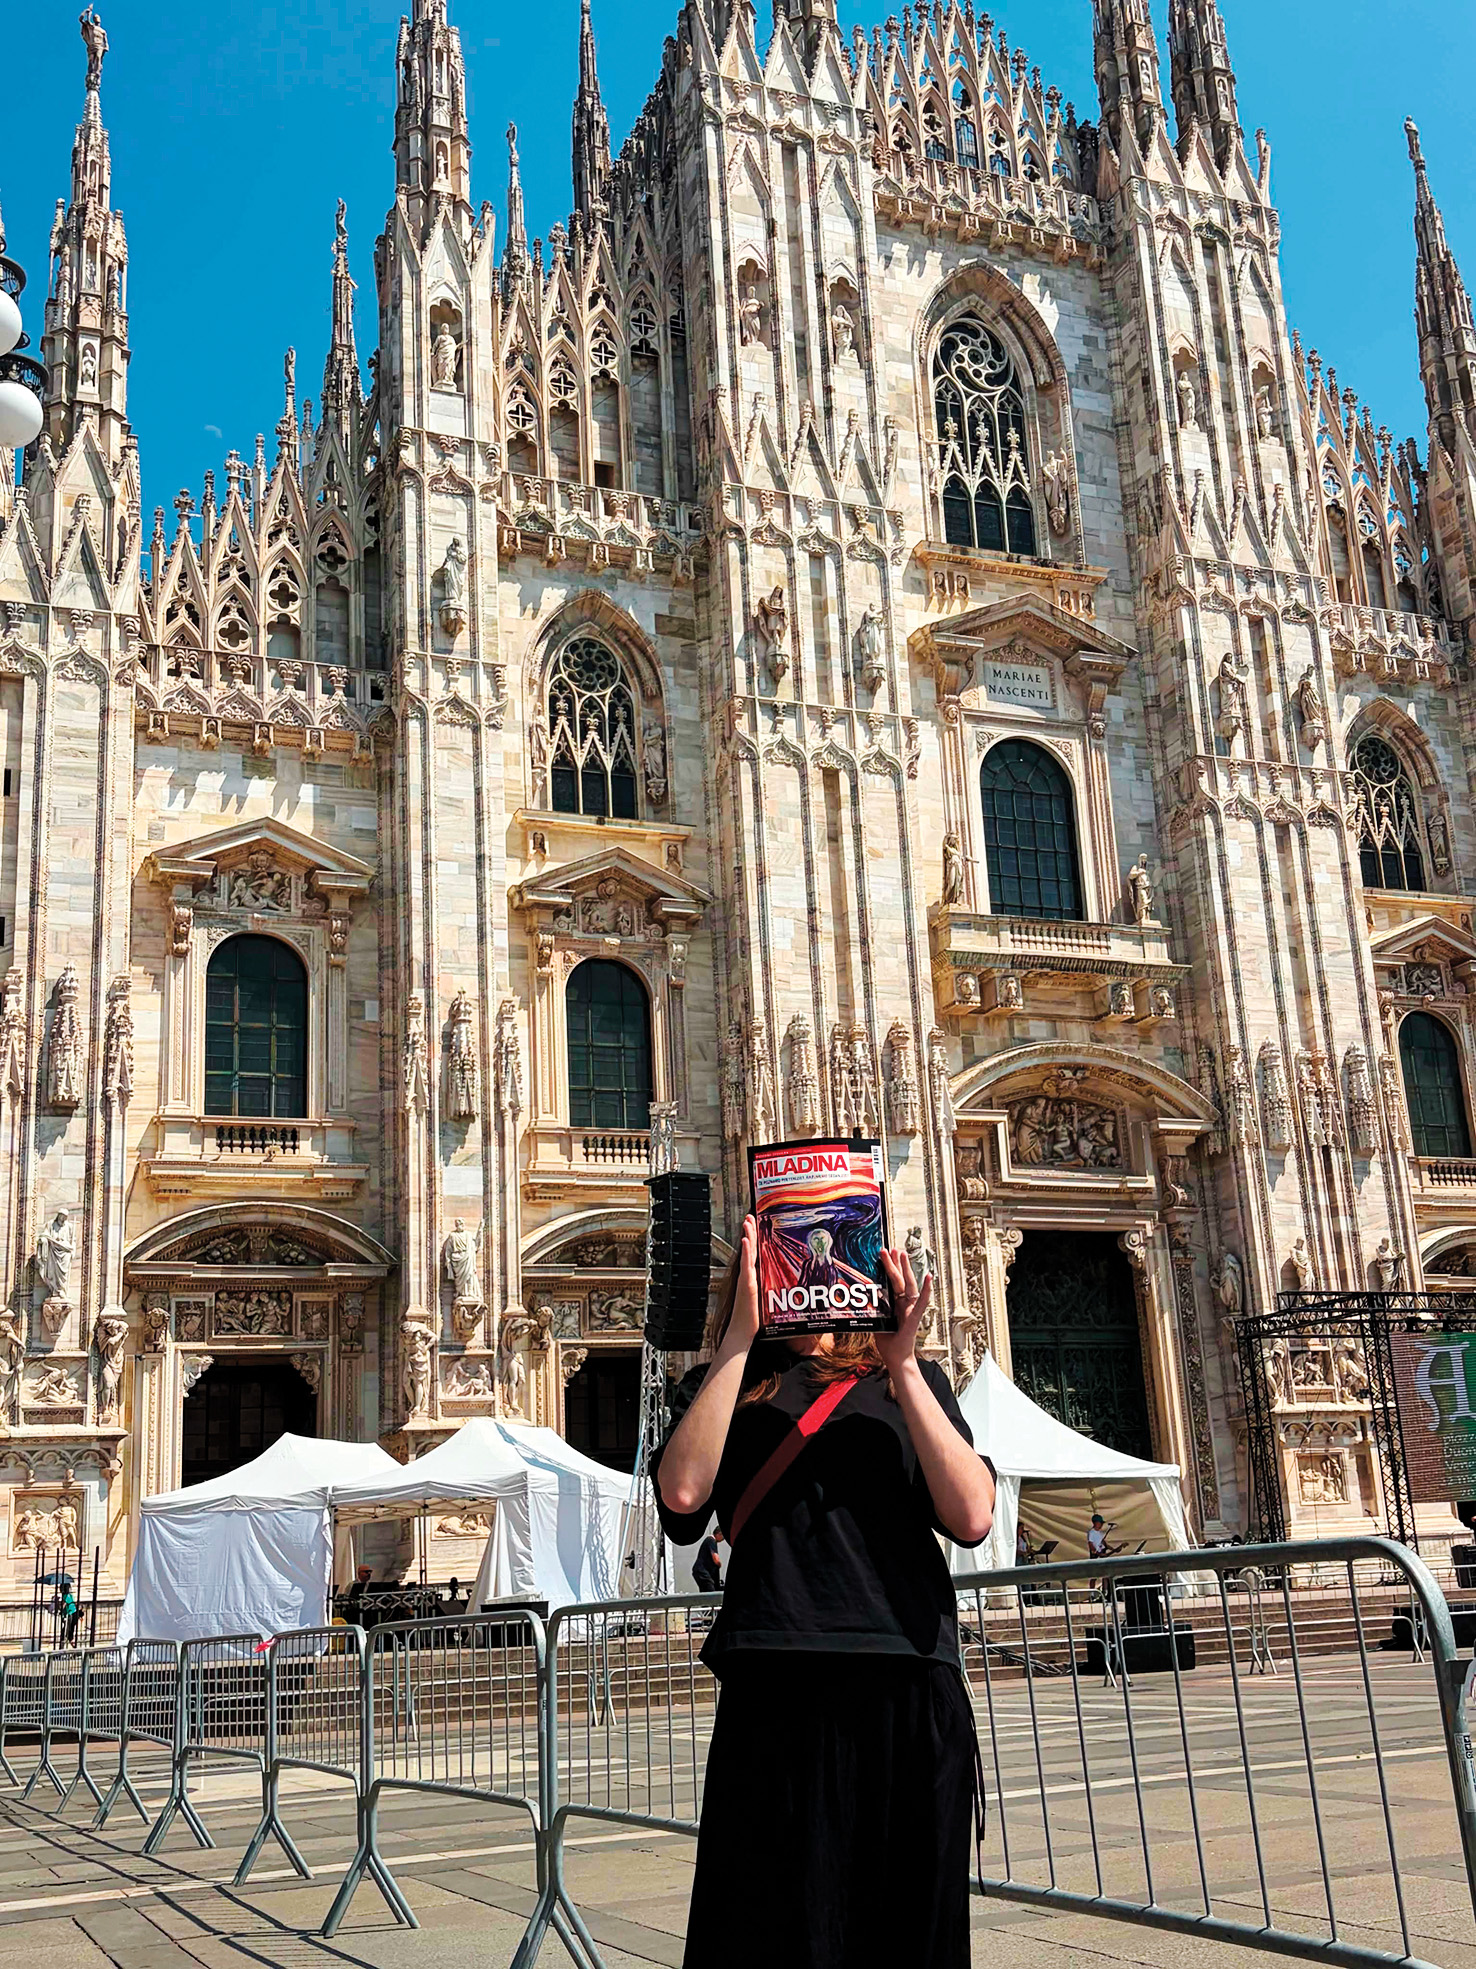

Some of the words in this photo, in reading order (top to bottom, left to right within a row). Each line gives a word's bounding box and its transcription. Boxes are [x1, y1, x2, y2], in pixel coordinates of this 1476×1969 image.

[993, 669, 1041, 683] MARIAE
[988, 685, 1049, 700] NASCENTI
[757, 1154, 848, 1179] MLADINA
[768, 1283, 882, 1313] NOROST
